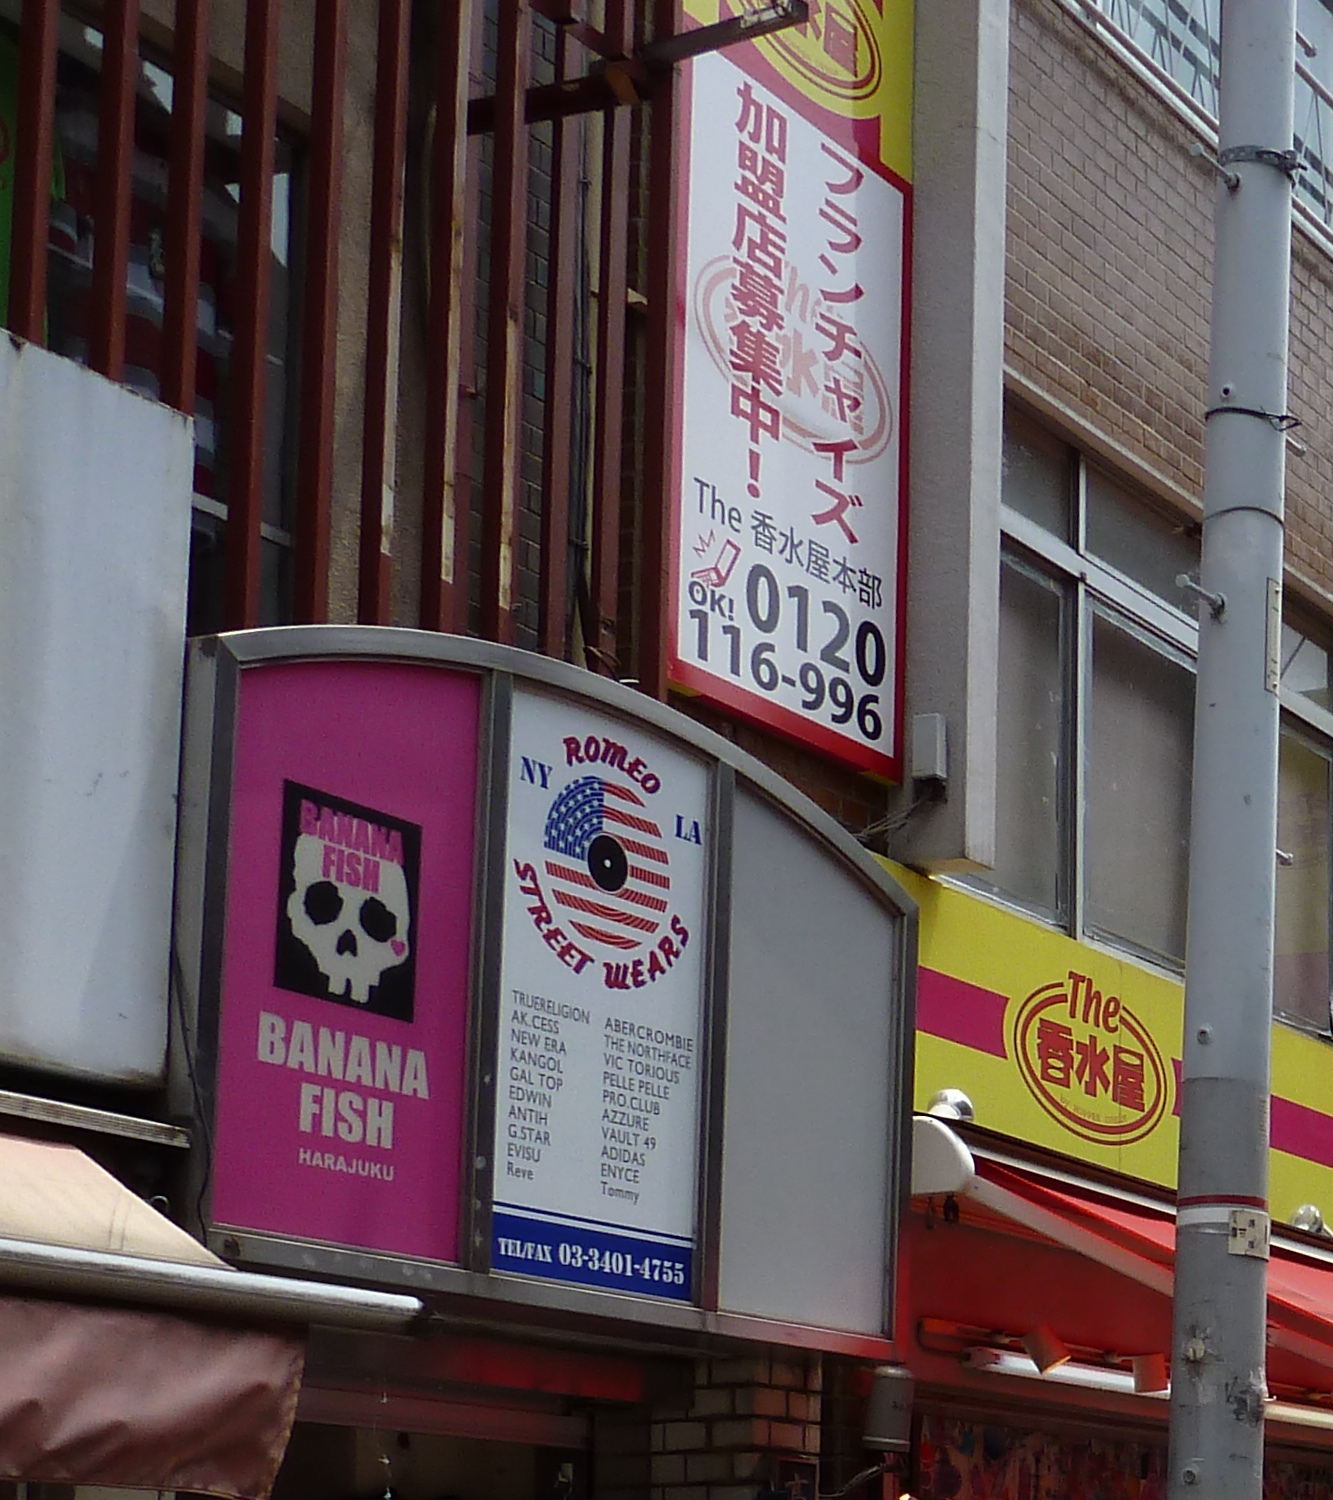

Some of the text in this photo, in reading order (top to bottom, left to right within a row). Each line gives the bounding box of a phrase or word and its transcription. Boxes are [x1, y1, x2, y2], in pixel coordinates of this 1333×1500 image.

[728, 80, 788, 500] 加盟店募集中！
[811, 140, 865, 546] フランチャイズ
[691, 476, 883, 611] The 香水屋本部
[688, 577, 736, 622] OK!
[745, 561, 886, 688] 0120
[687, 608, 884, 743] 116-996
[520, 756, 553, 790] NY
[562, 735, 661, 794] ROMEO
[299, 798, 405, 865] BANANA
[675, 814, 703, 845] LA
[321, 843, 381, 895] FISH
[513, 858, 689, 990] STREET WEARS
[511, 990, 590, 1024] TRUERELIGION
[1067, 969, 1122, 1035] The
[511, 1028, 567, 1056] NEW ERA
[604, 1017, 694, 1052] ABERCROMBIE
[256, 1010, 430, 1100] BANANA
[510, 1047, 564, 1075] KANGOL
[604, 1034, 692, 1070] THE NORTHFACE
[604, 1052, 680, 1086] VIC TORIOUS
[1036, 1016, 1146, 1113] 香水屋
[509, 1066, 564, 1092] GAL TOP
[603, 1071, 671, 1101] PELLE PELLE
[509, 1085, 552, 1108] EDWIN
[603, 1089, 661, 1116] PRO.CLUB
[299, 1084, 395, 1150] FISH
[508, 1104, 549, 1127] ANTIH
[602, 1109, 650, 1132] AZZURE
[508, 1123, 551, 1147] G.STAR
[601, 1125, 657, 1150] VAULT 49
[298, 1146, 395, 1183] HARAJUKU
[507, 1142, 542, 1163] EVISU
[601, 1144, 646, 1168] ADIDAS
[506, 1161, 535, 1181] Reve
[600, 1163, 640, 1185] ENYCE
[600, 1181, 640, 1206] Tommy
[498, 1237, 686, 1285] TEL/FAX 03-3401-4755
